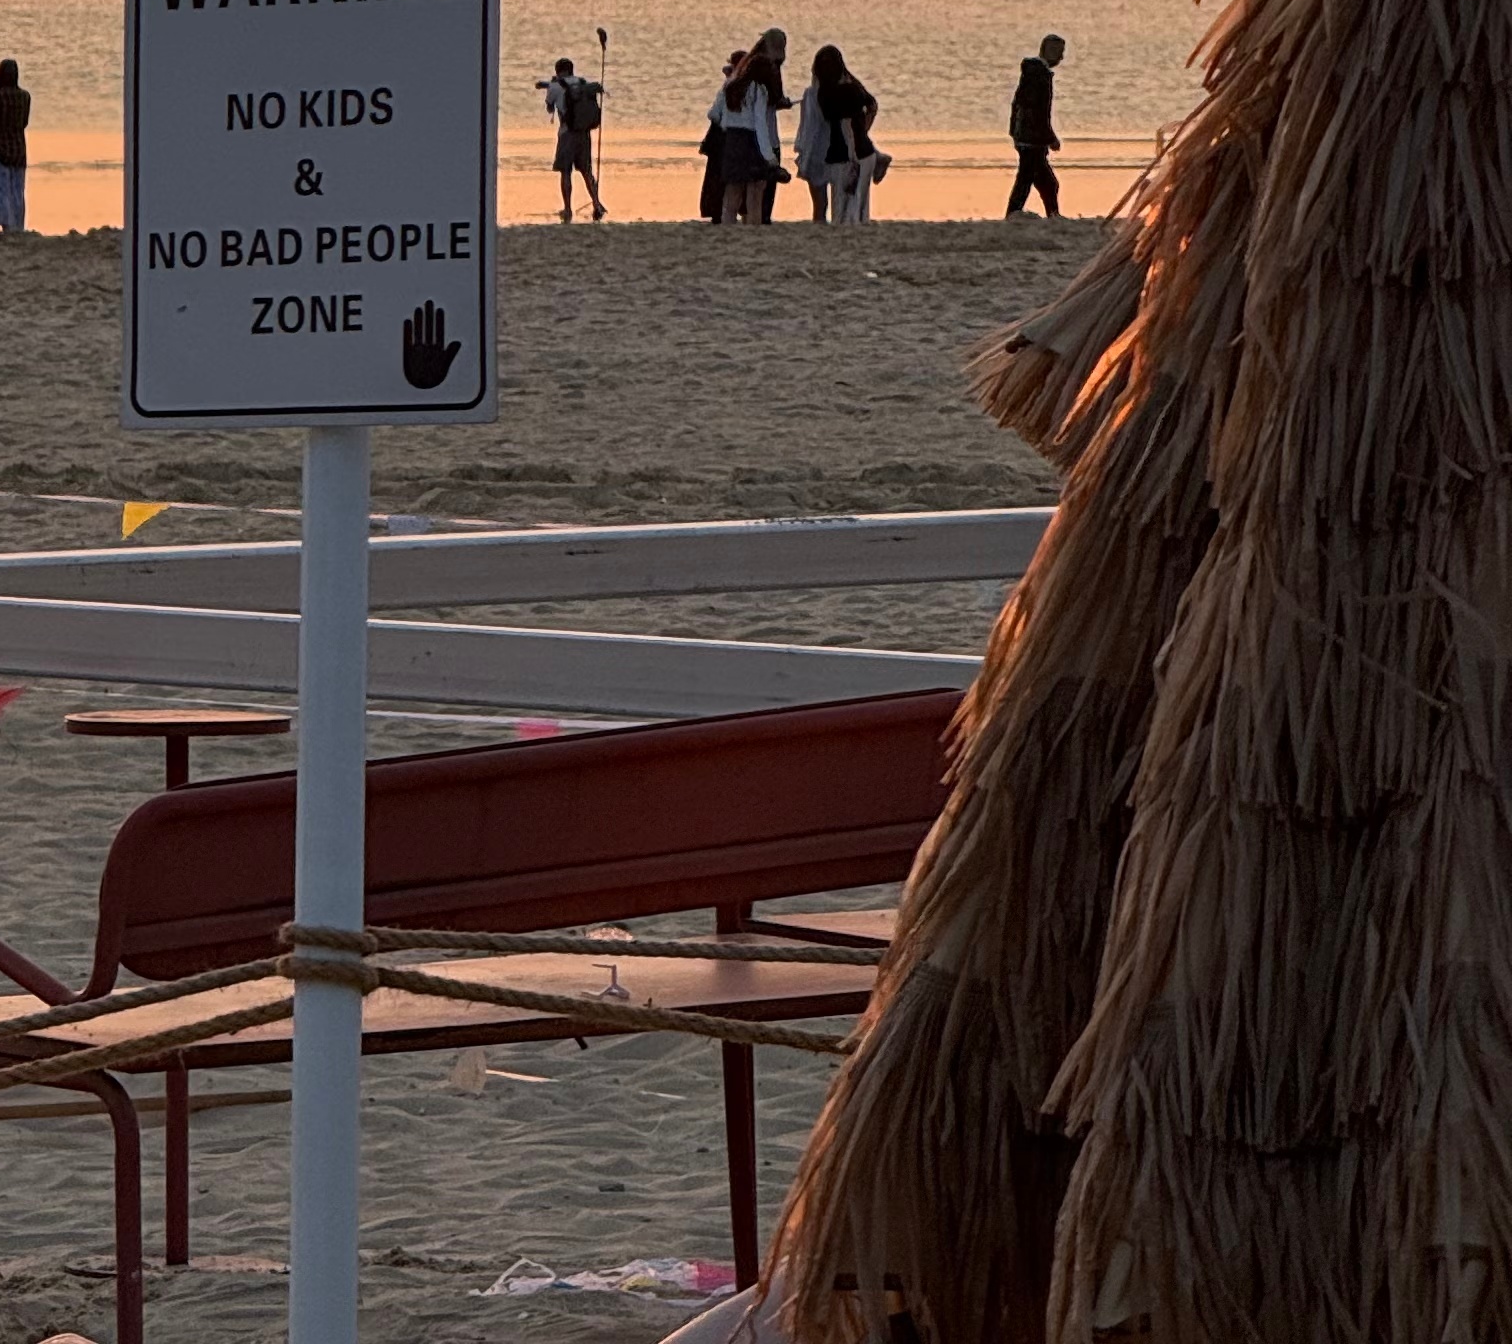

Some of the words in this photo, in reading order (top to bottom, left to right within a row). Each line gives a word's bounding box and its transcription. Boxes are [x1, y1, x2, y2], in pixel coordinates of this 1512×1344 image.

[227, 92, 285, 130] NO
[300, 88, 392, 127] KIDS
[295, 159, 323, 196] &
[150, 231, 207, 269] NO
[221, 229, 302, 267] BAD
[317, 222, 470, 263] PEOPLE
[252, 295, 362, 334] ZONE
